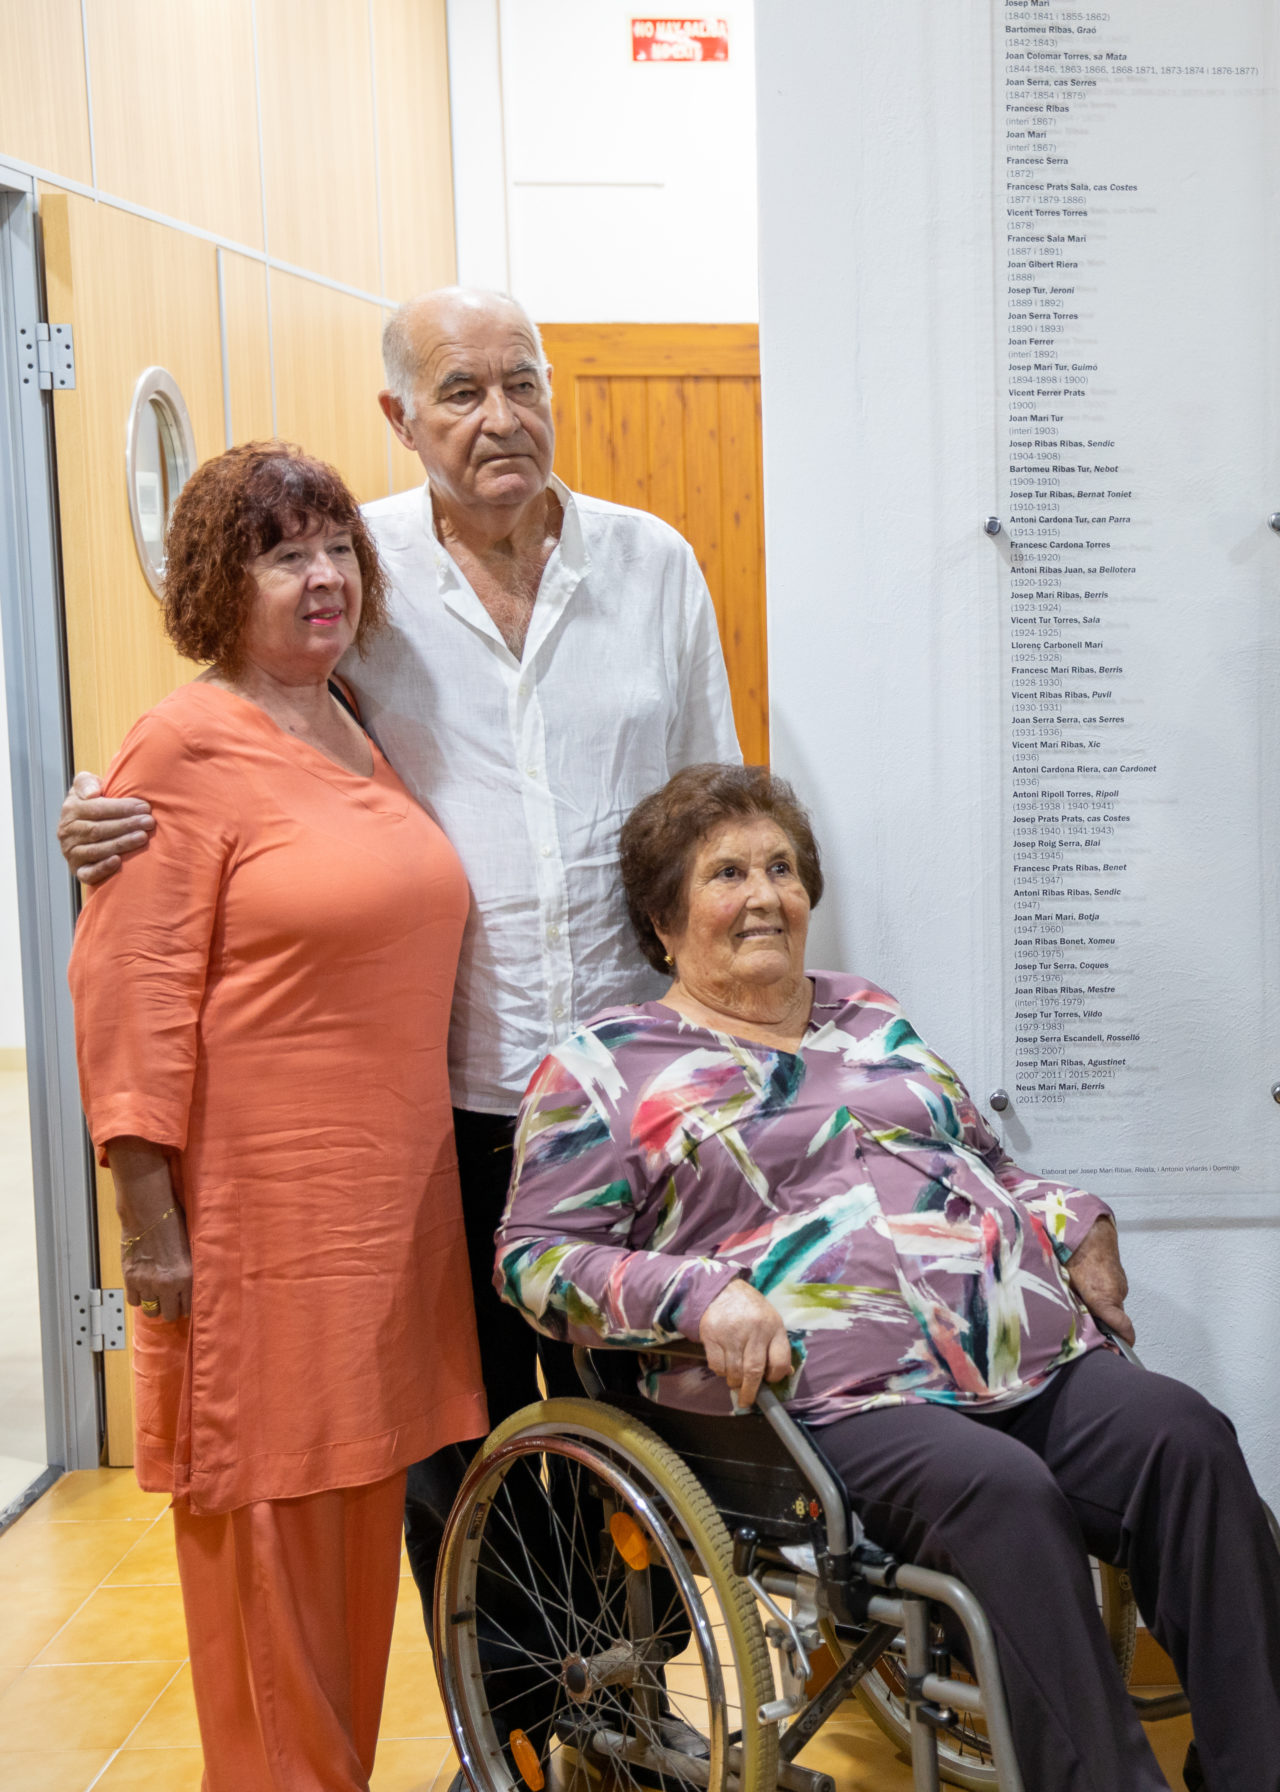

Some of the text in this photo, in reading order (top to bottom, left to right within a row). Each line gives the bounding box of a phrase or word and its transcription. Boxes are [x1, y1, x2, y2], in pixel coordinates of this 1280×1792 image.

[1106, 53, 1127, 61] Mata
[1046, 157, 1069, 165] Serra
[1007, 170, 1034, 178] (1872)
[1047, 183, 1069, 191] Prats
[1007, 222, 1035, 230] (1878)
[1007, 287, 1031, 296] Josep
[1008, 364, 1032, 373] Josep
[1009, 402, 1037, 410] (1900)
[1009, 440, 1033, 449] Josep
[1009, 491, 1033, 500] Josep
[1077, 490, 1105, 498] Bernat
[1107, 490, 1132, 498] Toniet
[1109, 515, 1131, 523] Parra
[1010, 591, 1034, 600] Josep
[1012, 641, 1041, 650] Llorenç
[1012, 753, 1039, 761] (1936)
[1013, 765, 1039, 773] Antoni
[1013, 778, 1039, 786] (1936)
[1041, 790, 1064, 799] Ripoll
[1096, 790, 1119, 799] Ripoll
[1012, 815, 1036, 824] Josep
[1013, 840, 1036, 849] Josep
[1038, 840, 1056, 849] Roig
[1014, 901, 1040, 909] (1947)
[1013, 913, 1032, 921] Joan
[1014, 962, 1037, 971] Josep
[1080, 961, 1109, 970] Coques
[1014, 1011, 1038, 1020] Josep
[1015, 1035, 1038, 1044] Josep
[1015, 1060, 1038, 1069] Josep
[1088, 1058, 1126, 1067] Agustinet
